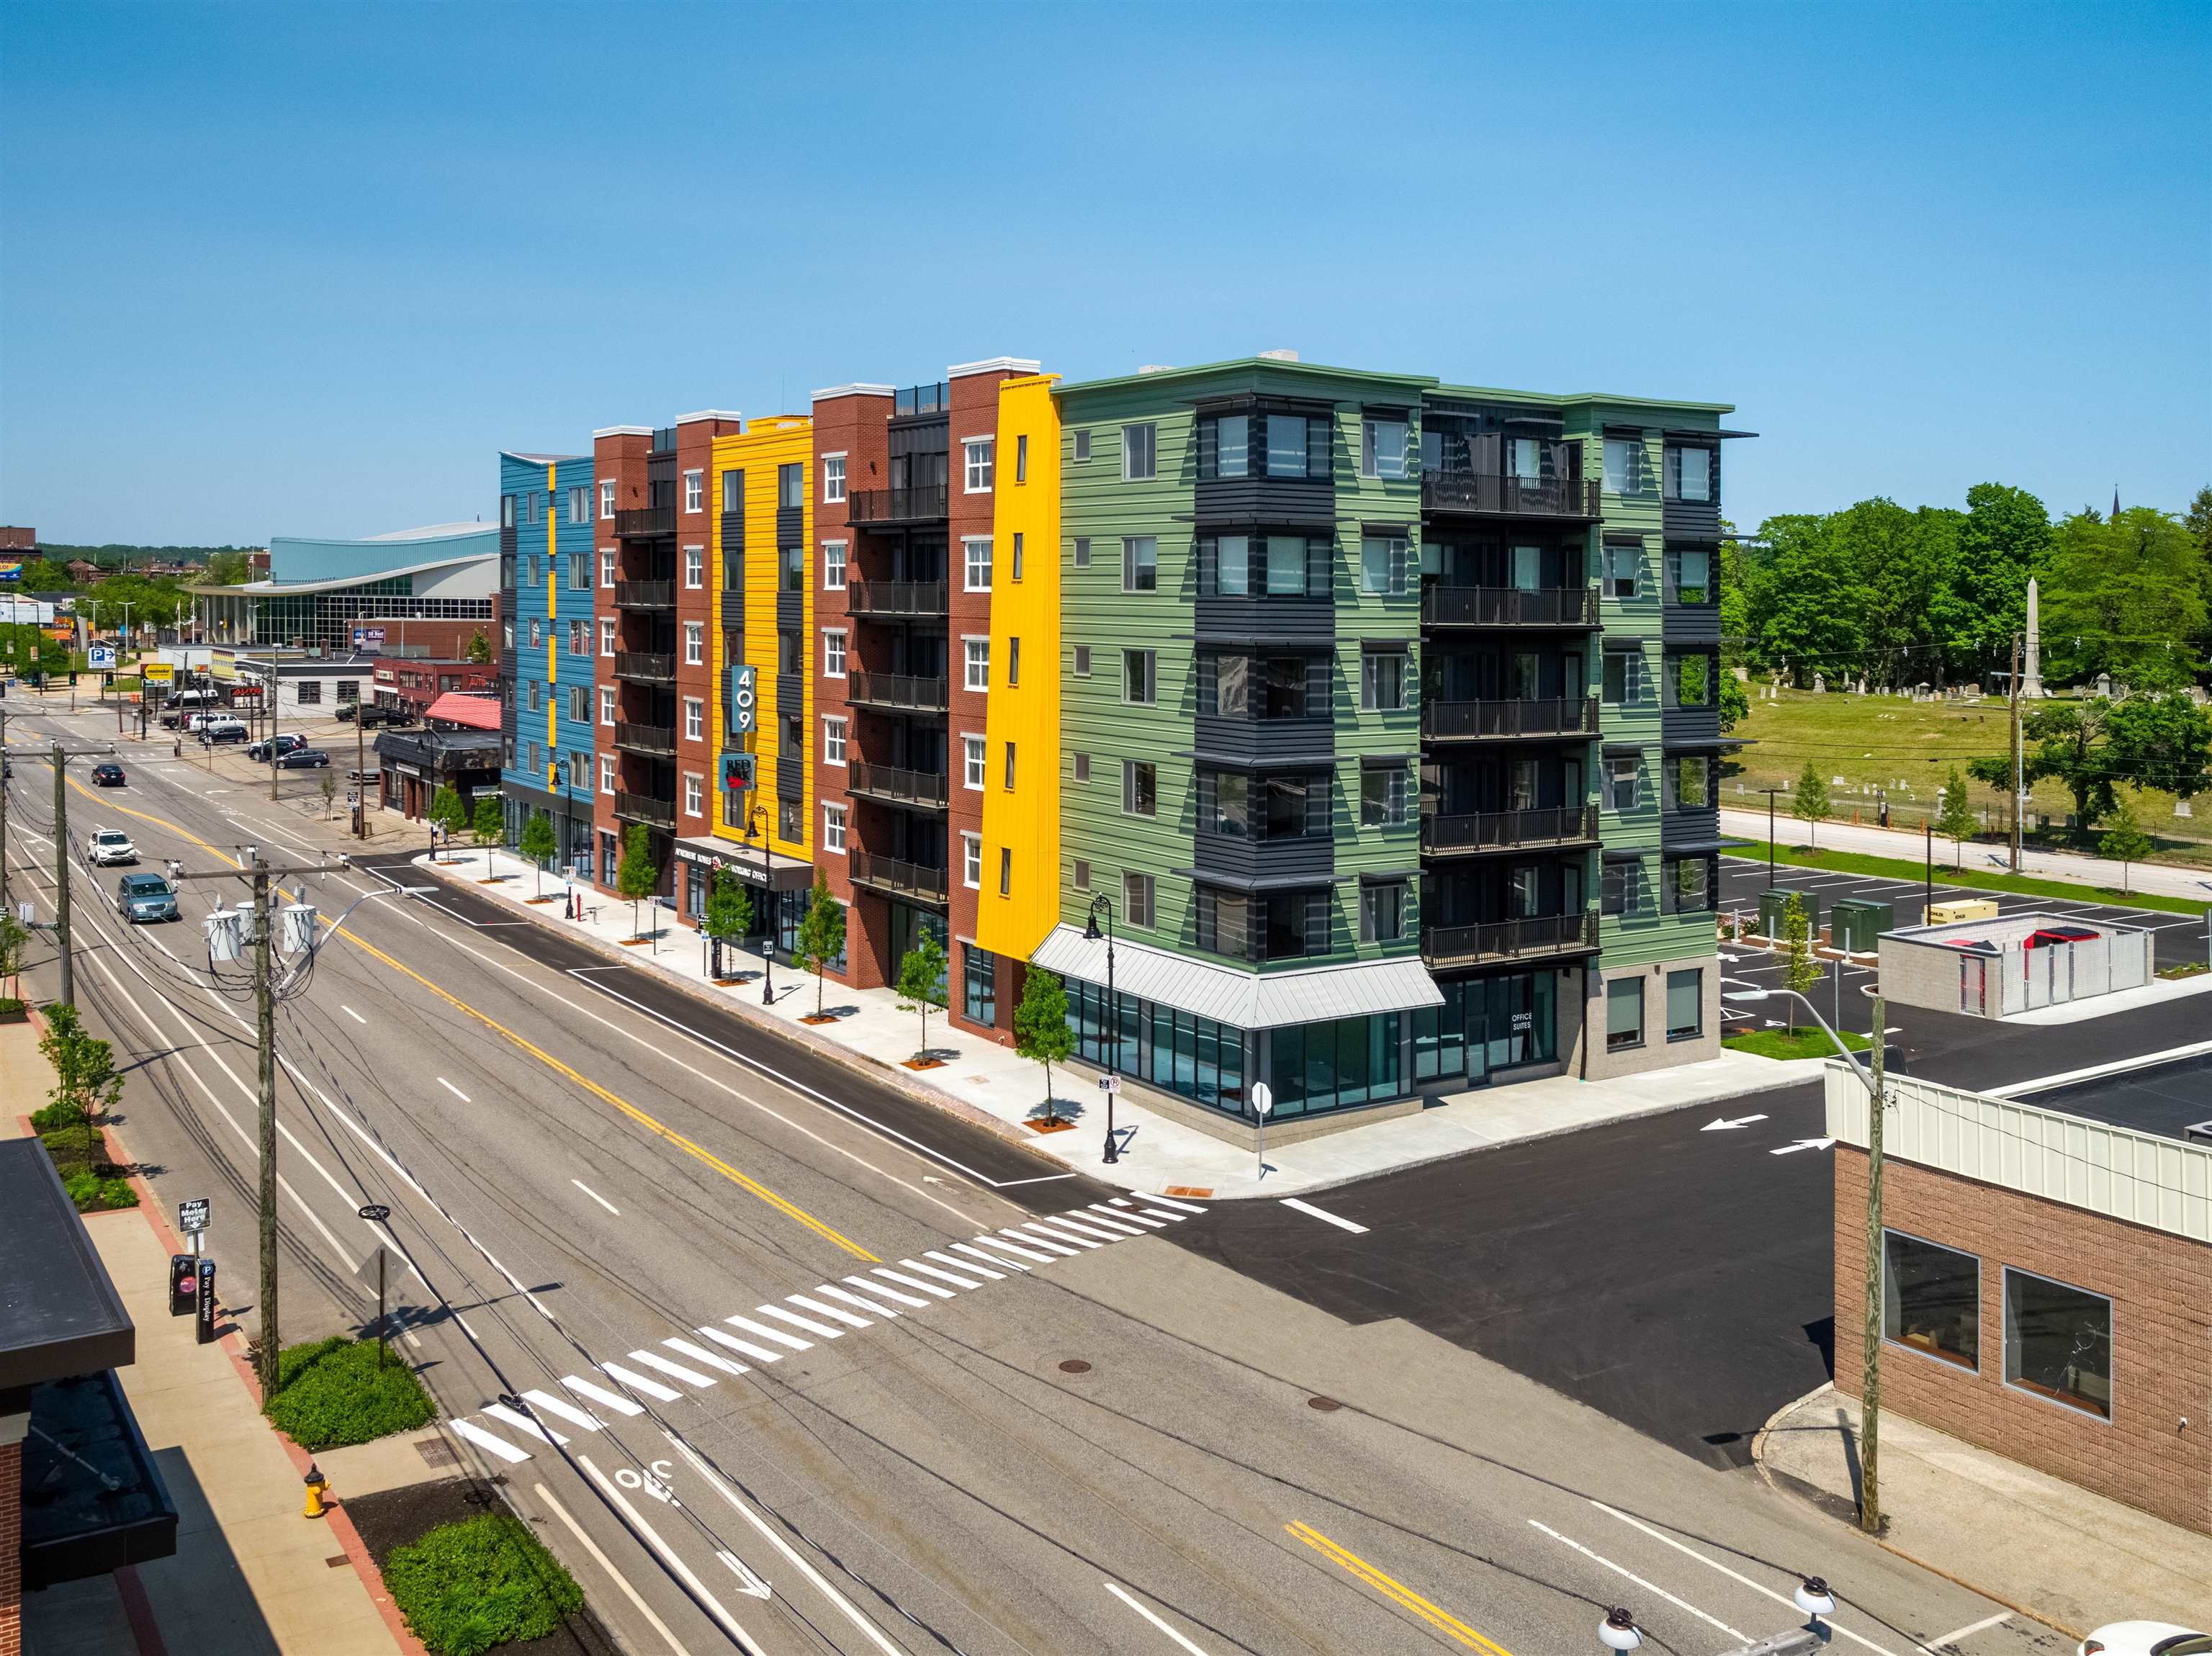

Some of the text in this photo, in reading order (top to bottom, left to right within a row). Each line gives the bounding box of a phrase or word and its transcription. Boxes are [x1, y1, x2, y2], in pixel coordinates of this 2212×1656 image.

[232, 687, 263, 696] AUTO
[737, 670, 753, 729] 409
[1511, 1012, 1532, 1022] OFFICE
[1513, 1021, 1531, 1030] SUITES
[181, 1207, 208, 1217] Meter
[202, 1277, 211, 1289] Pay
